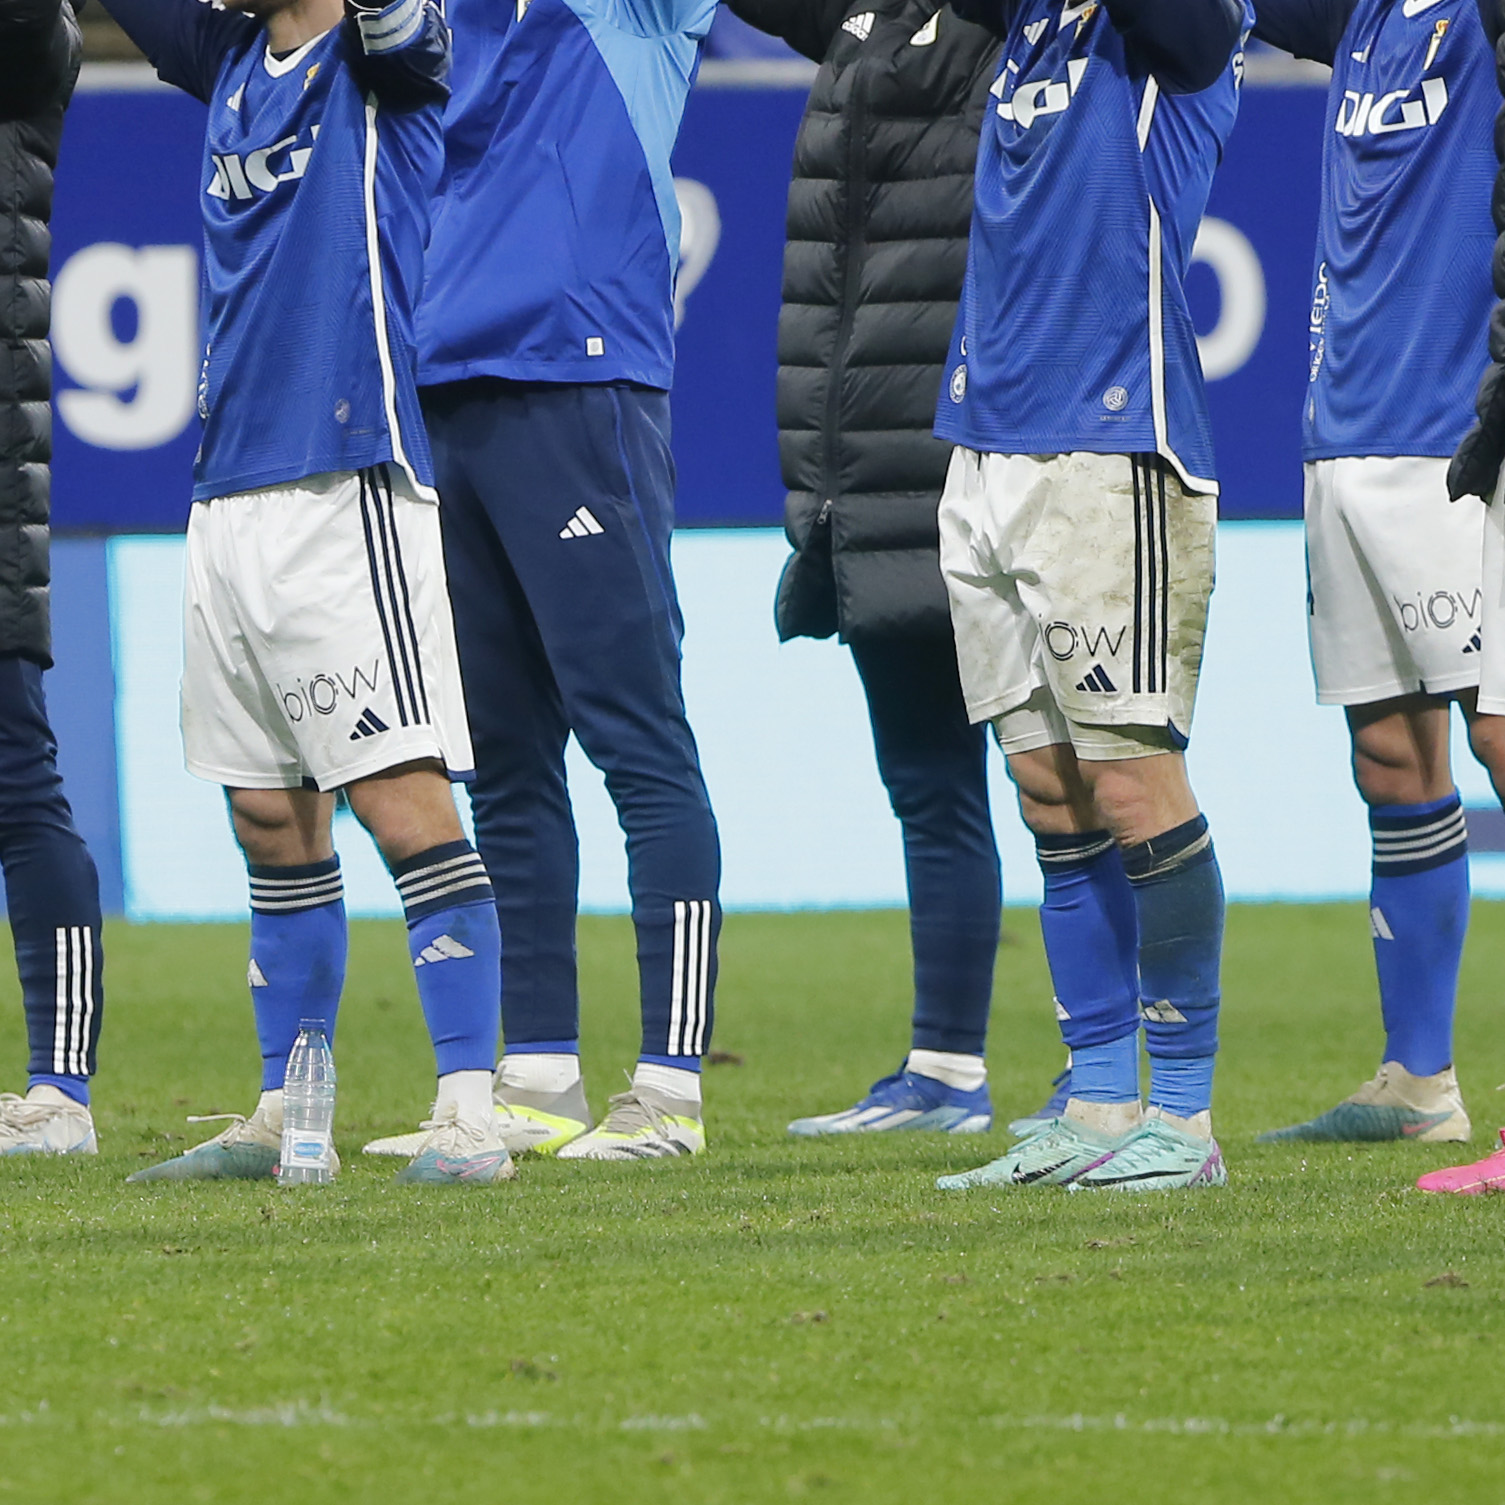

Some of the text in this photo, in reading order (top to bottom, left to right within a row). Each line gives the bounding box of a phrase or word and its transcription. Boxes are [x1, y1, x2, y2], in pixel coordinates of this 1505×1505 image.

[206, 124, 321, 201] DIG
[1037, 613, 1127, 661] iow
[276, 658, 380, 724] biow
